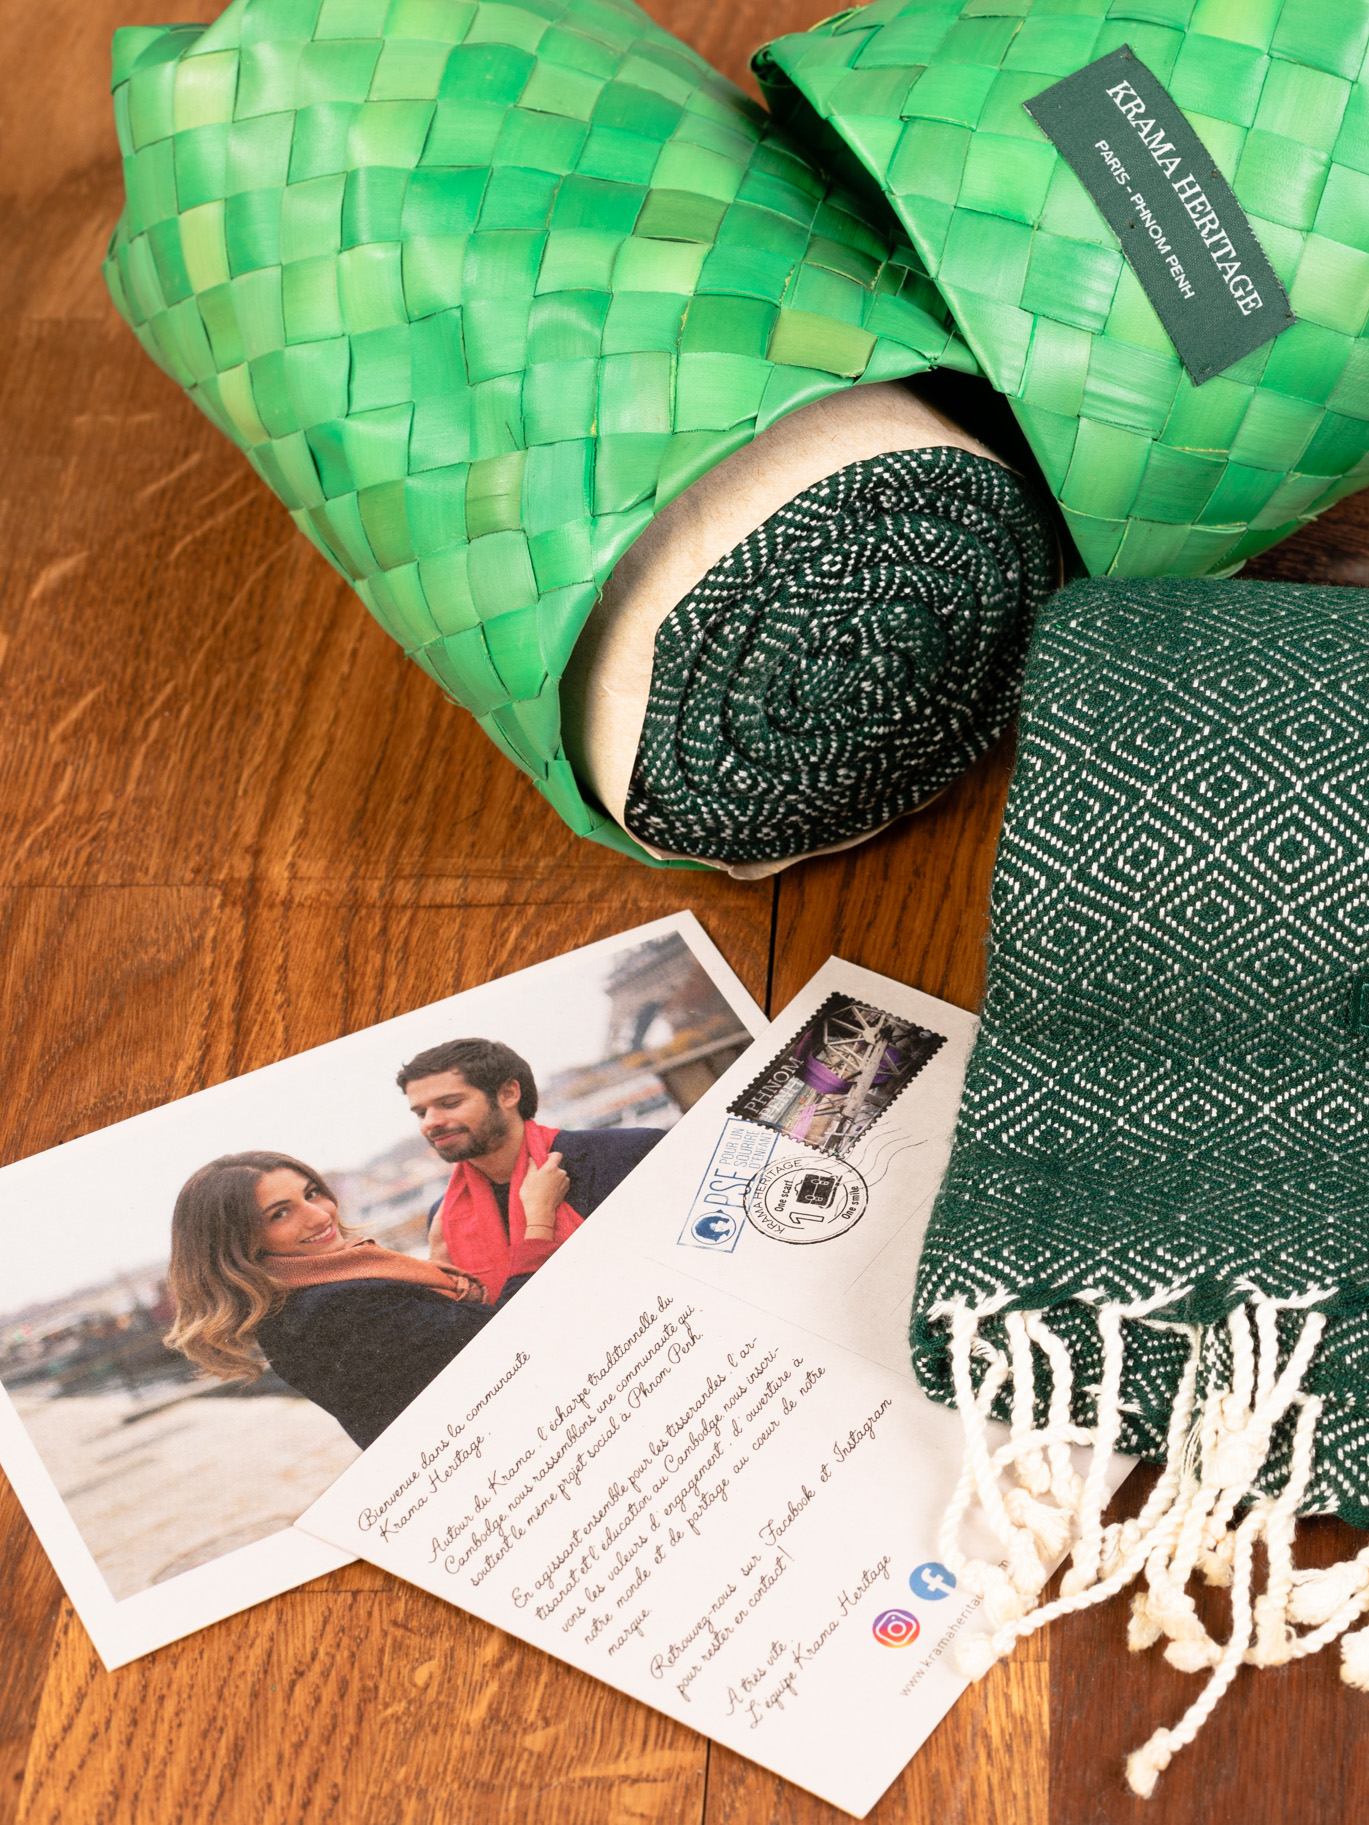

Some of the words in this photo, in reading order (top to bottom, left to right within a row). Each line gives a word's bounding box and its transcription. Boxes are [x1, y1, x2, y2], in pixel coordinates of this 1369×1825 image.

[1095, 139, 1130, 185] PARIS
[1130, 193, 1171, 255] PHNOM
[1165, 254, 1195, 300] PENH
[1106, 80, 1182, 179] KRAMA
[1172, 173, 1264, 316] HERITAGE
[744, 1056, 804, 1114] PHNOM
[719, 1142, 739, 1165] POUR
[731, 1128, 745, 1140] UN
[734, 1130, 760, 1168] SOURIRE
[749, 1132, 772, 1169] D'ENFANT
[753, 1159, 802, 1199] HERITAGE
[753, 1202, 785, 1234] KRAMA
[774, 1200, 787, 1212] One
[841, 1206, 856, 1220] One
[851, 1186, 860, 1206] smile
[428, 1515, 474, 1563] Autour
[475, 1495, 491, 1513] du
[587, 1311, 658, 1386] traditionnelle
[658, 1296, 674, 1313] du
[470, 1534, 514, 1587] soutient
[510, 1525, 526, 1540] le
[557, 1452, 587, 1501] projet
[587, 1416, 620, 1458] social
[620, 1411, 632, 1422] à
[627, 1367, 672, 1409] Phnom
[668, 1326, 704, 1364] Penh.
[508, 1485, 533, 1512] nous
[532, 1415, 596, 1482] rassemblons
[596, 1393, 616, 1414] une
[678, 1305, 696, 1335] qui
[358, 1471, 420, 1531] Bienvenue
[421, 1439, 450, 1469] dans
[447, 1423, 465, 1438] la
[379, 1495, 428, 1543] Krama
[511, 1587, 534, 1608] En
[535, 1529, 583, 1589] agissant
[583, 1482, 629, 1535] ensemble
[628, 1458, 652, 1493] pour
[649, 1439, 668, 1456] les
[535, 1569, 581, 1621] tisanat
[580, 1554, 593, 1575] et
[653, 1476, 668, 1493] au
[723, 1386, 747, 1412] nous
[746, 1347, 779, 1385] inscri-
[584, 1613, 613, 1644] notre
[616, 1567, 651, 1609] monde
[654, 1543, 666, 1565] et
[669, 1528, 684, 1547] de
[686, 1479, 730, 1535] partage
[733, 1456, 750, 1474] au
[752, 1420, 780, 1451] coeur
[782, 1397, 797, 1415] de
[799, 1367, 826, 1396] notre
[562, 1606, 586, 1633] vons
[584, 1584, 605, 1602] les
[608, 1536, 648, 1581] valeurs
[650, 1584, 737, 1679] Retrouvez-nous
[740, 1554, 761, 1576] sur
[758, 1485, 816, 1547] Facebook
[820, 1463, 832, 1483] et
[833, 1398, 892, 1463] Instagram
[676, 1665, 702, 1702] pour
[701, 1627, 734, 1661] rester
[734, 1609, 749, 1625] en
[792, 1620, 839, 1670] Krama
[837, 1555, 891, 1617] Heritage
